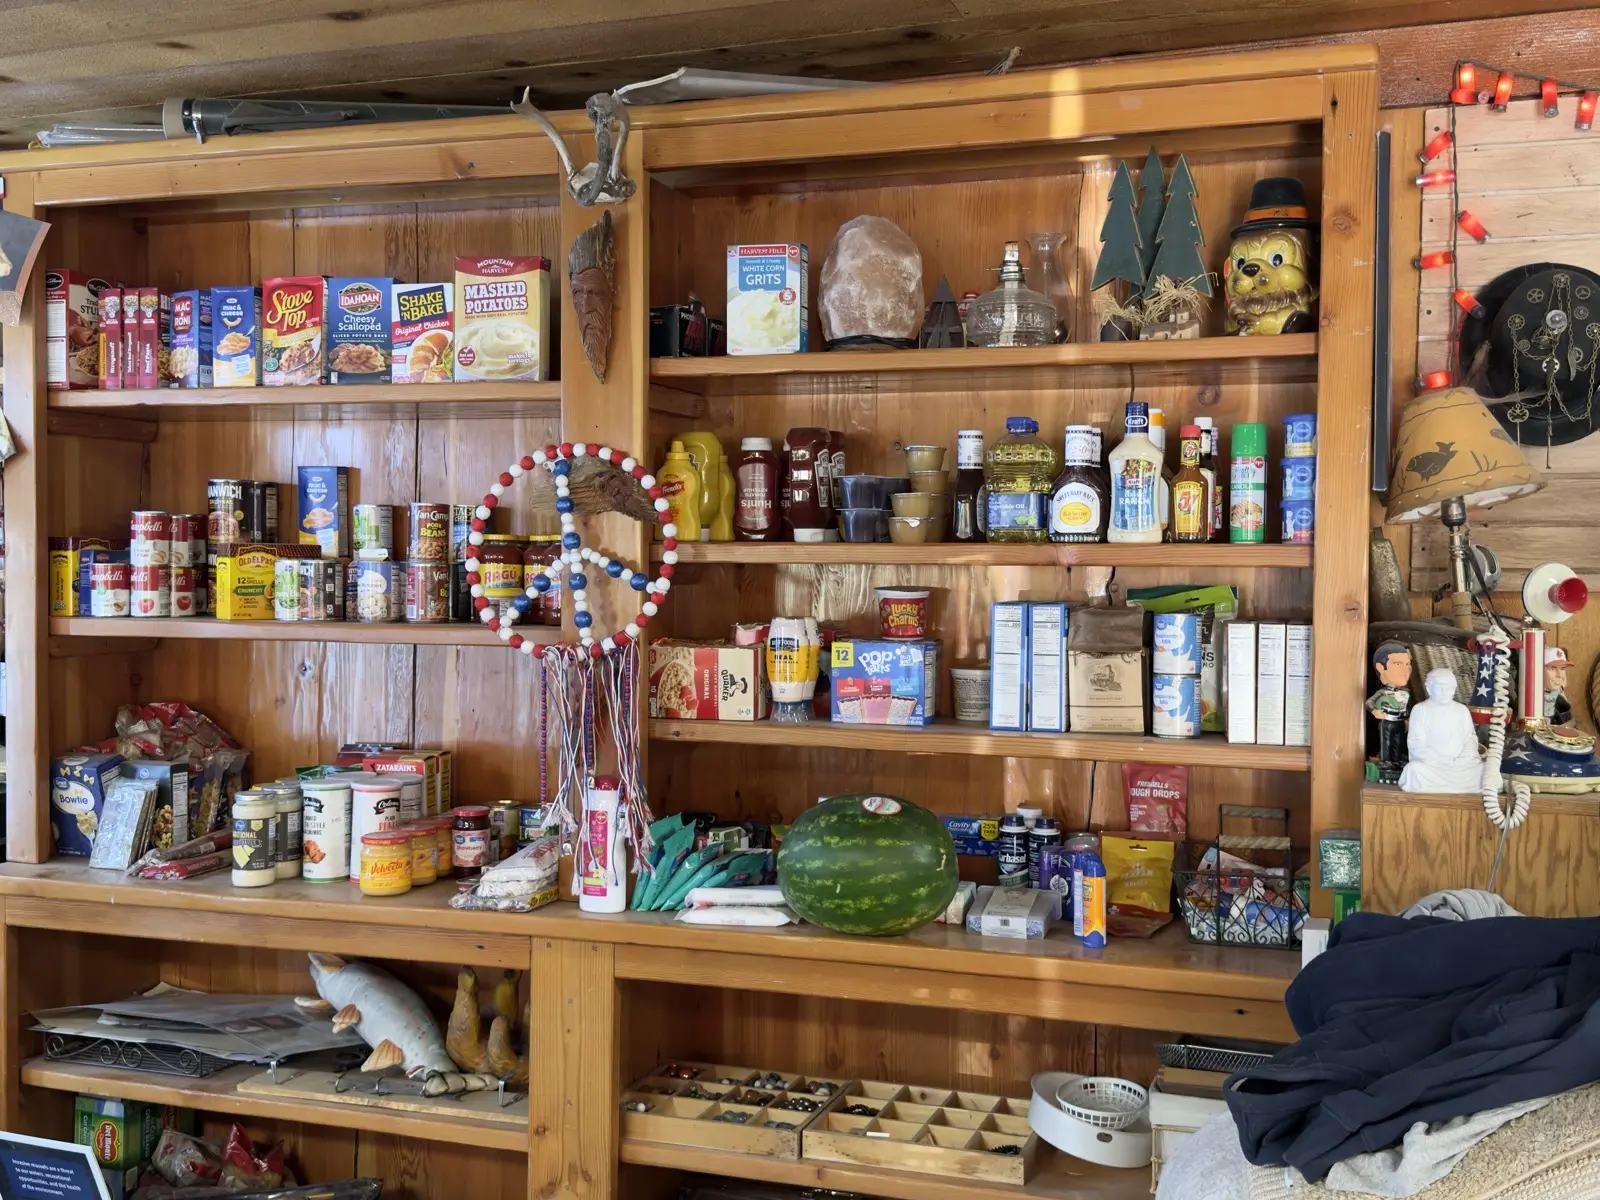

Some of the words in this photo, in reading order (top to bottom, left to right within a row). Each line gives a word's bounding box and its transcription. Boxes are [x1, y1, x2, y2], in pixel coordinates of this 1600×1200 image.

[477, 258, 514, 268] MOUNTAIN
[746, 274, 781, 285] GRITS
[464, 281, 526, 299] MASHED
[341, 292, 380, 306] IDAHOAN
[400, 291, 443, 311] SHAKE
[175, 301, 191, 312] MAC
[266, 290, 314, 324] Stove
[465, 297, 528, 313] POTATOES
[411, 303, 444, 321] BAKE
[175, 316, 191, 326] RONI
[283, 309, 307, 331] Top
[344, 315, 376, 324] Cheesy
[338, 323, 381, 332] Scalloped
[395, 323, 422, 336] Original
[424, 320, 450, 330] Chicken
[420, 527, 446, 538] BEANS
[238, 557, 251, 566] OLD
[261, 556, 274, 565] PAS
[891, 603, 918, 617] Lucky
[888, 615, 919, 628] Charms
[835, 650, 849, 661] 12
[721, 669, 729, 702] QUAKER
[376, 764, 417, 772] ZATARAIN'S
[1129, 788, 1150, 797] OUGH
[1152, 789, 1180, 799] DROPS
[59, 794, 89, 805] Bowtie
[949, 820, 971, 829] Cavity
[982, 822, 996, 830] 25%
[371, 859, 404, 873] Velveeta
[12, 1158, 30, 1167] Invasive
[31, 1162, 48, 1170] mussels
[60, 1167, 74, 1175] threat
[66, 1183, 82, 1191] health
